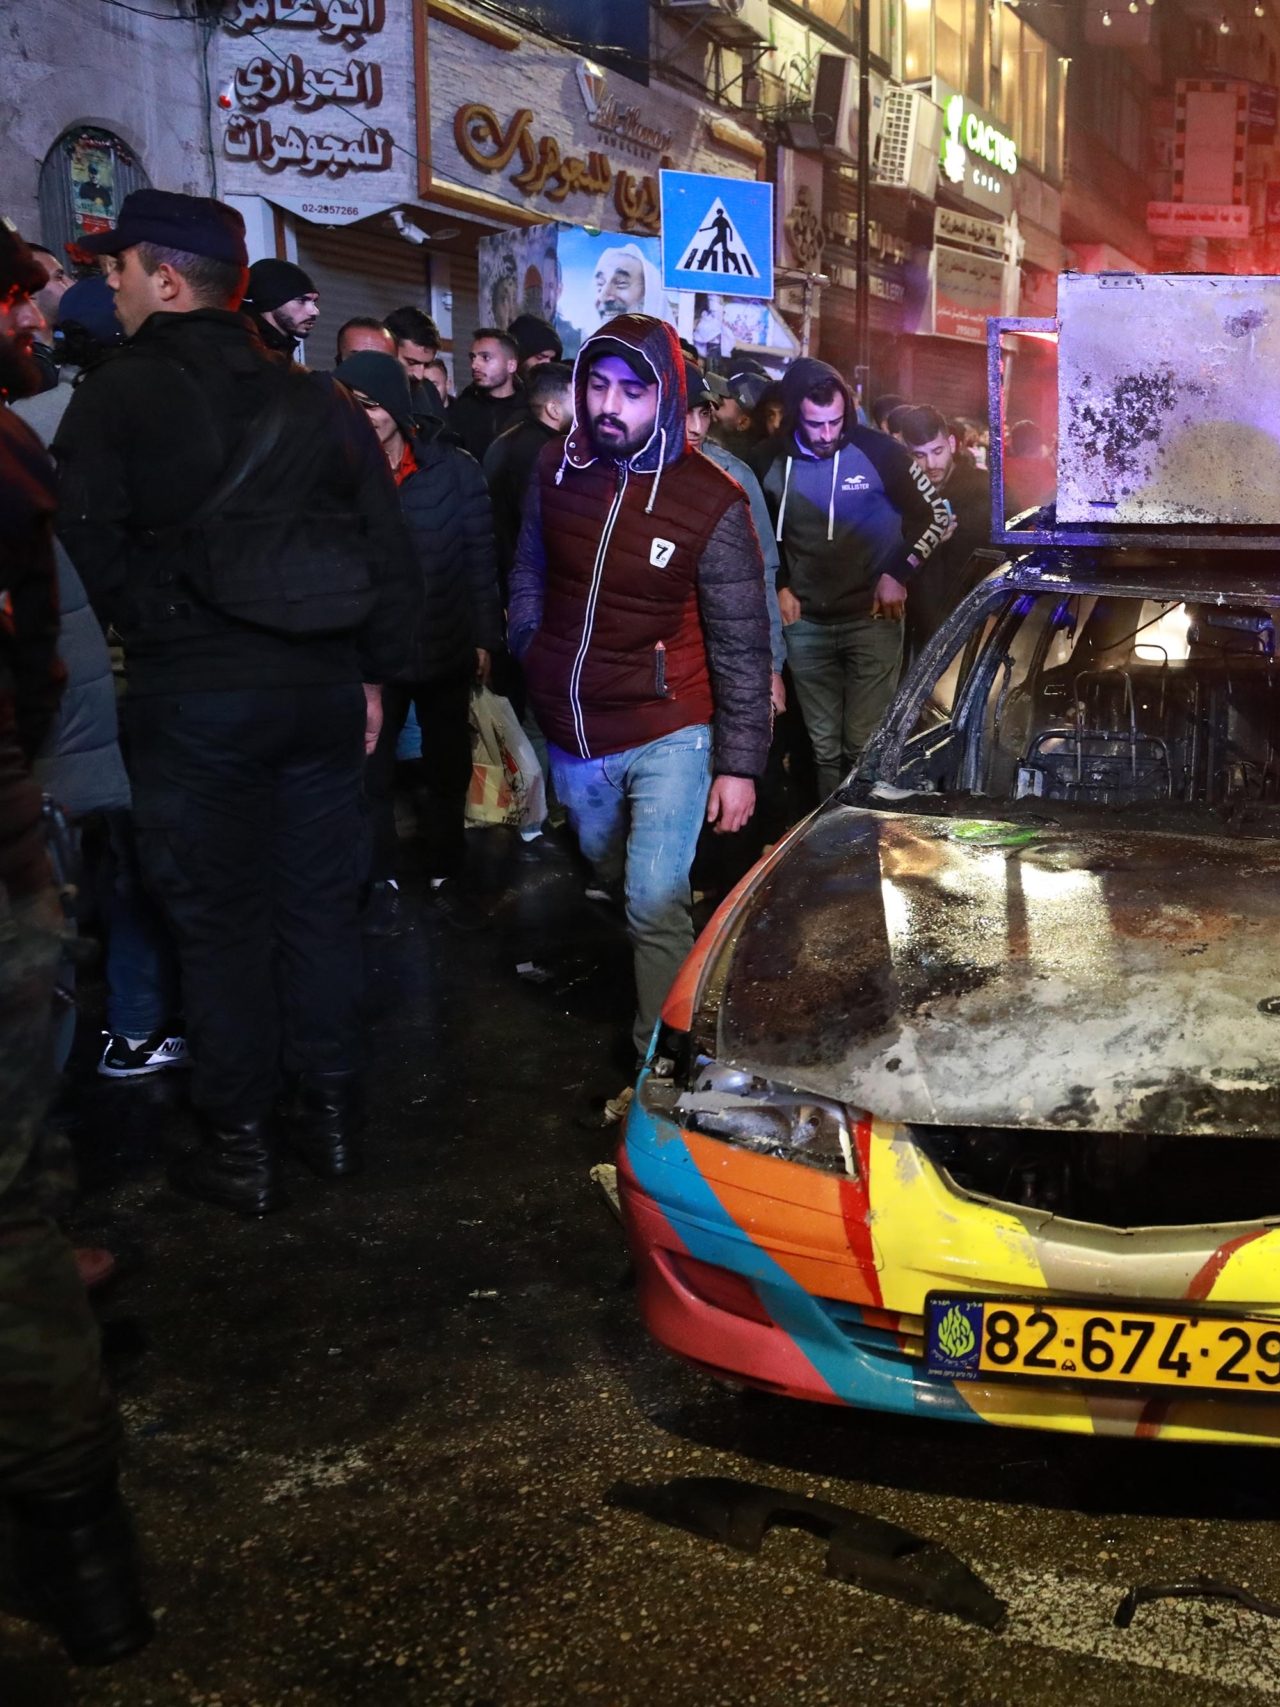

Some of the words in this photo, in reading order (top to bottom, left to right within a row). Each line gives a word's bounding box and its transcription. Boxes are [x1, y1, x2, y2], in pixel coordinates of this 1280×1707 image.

[234, 53, 382, 112] الحواري
[224, 114, 393, 179] للمجوهرات
[964, 112, 1018, 175] CACTUS
[841, 482, 870, 491] HOLLISTER
[655, 543, 669, 560] 7
